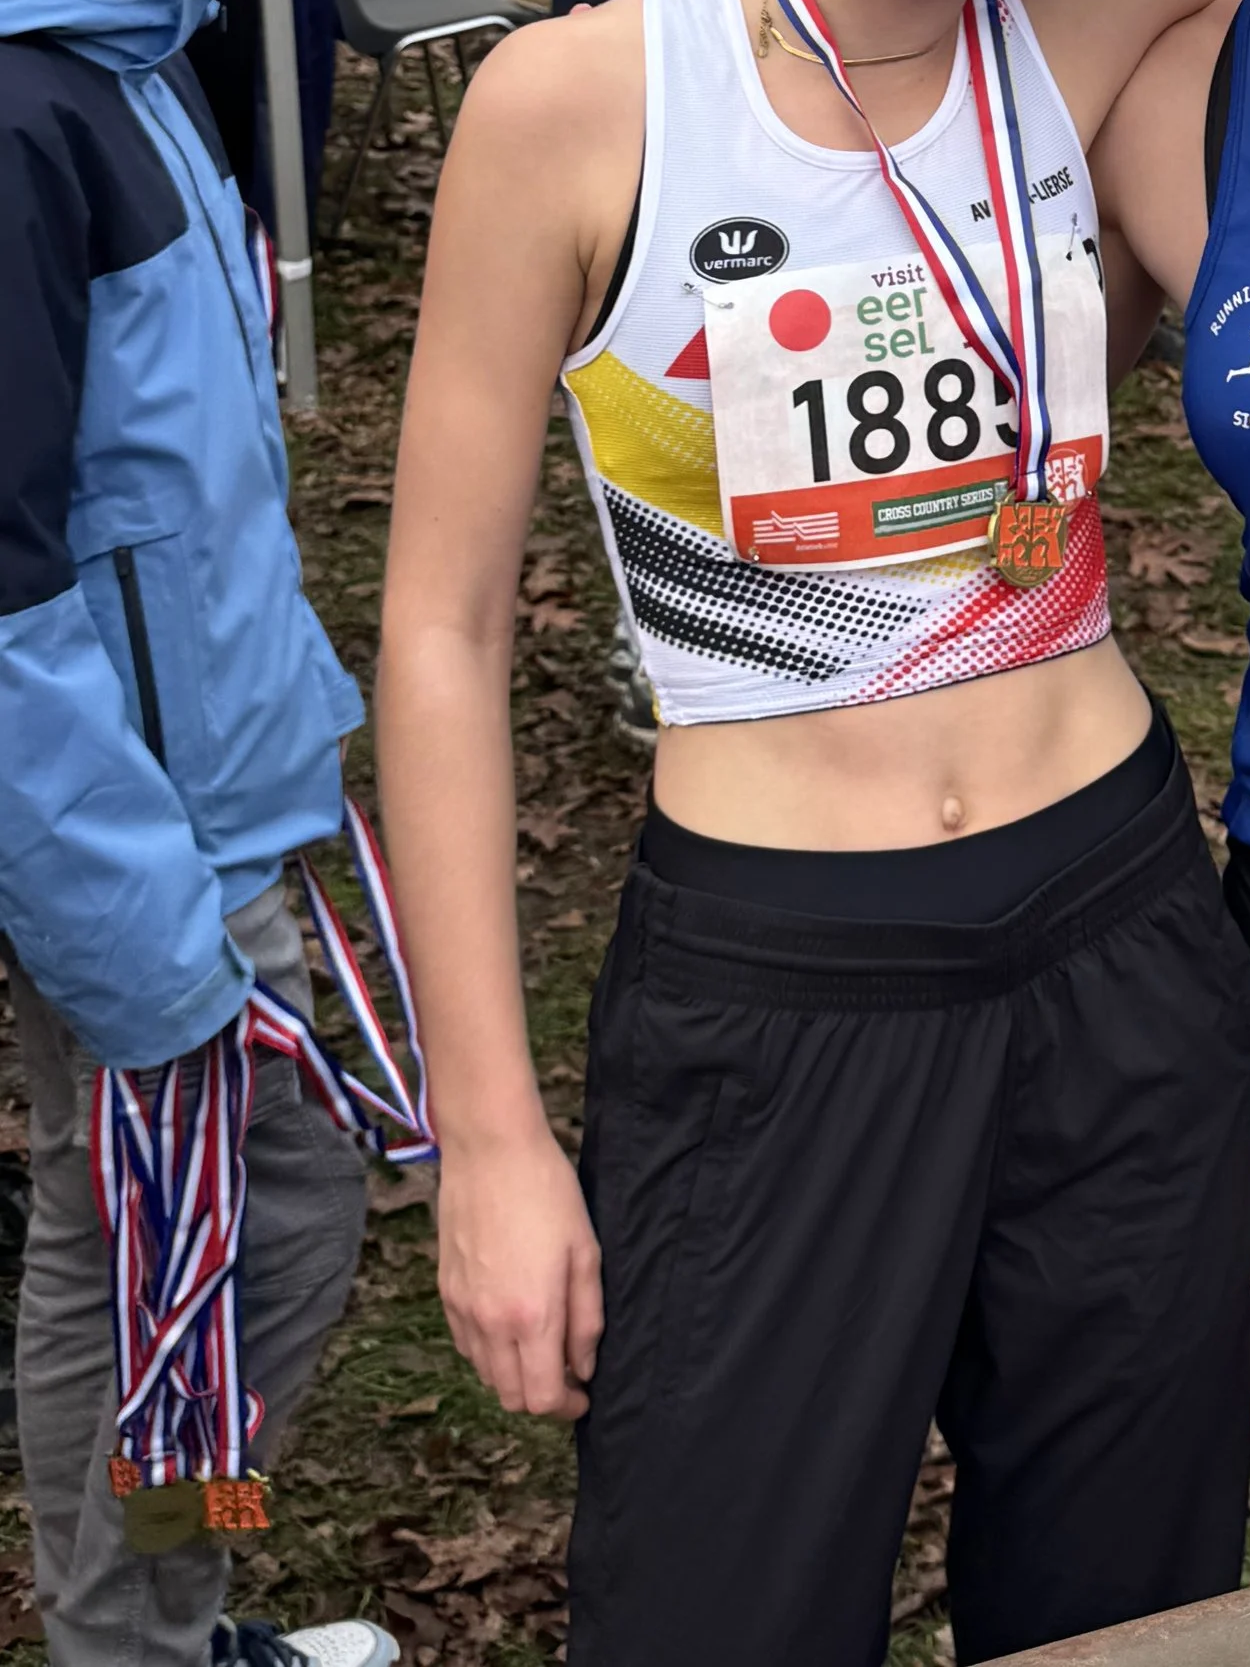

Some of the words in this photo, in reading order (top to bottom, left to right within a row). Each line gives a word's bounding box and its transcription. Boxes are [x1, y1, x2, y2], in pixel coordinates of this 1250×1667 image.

[1029, 166, 1074, 204] -LIERSE
[703, 253, 773, 271] vermarc
[871, 263, 926, 288] visit
[857, 287, 928, 326] eer
[877, 506, 910, 523] CROSS
[912, 496, 960, 517] COUNTRY
[961, 487, 994, 507] SERIES
